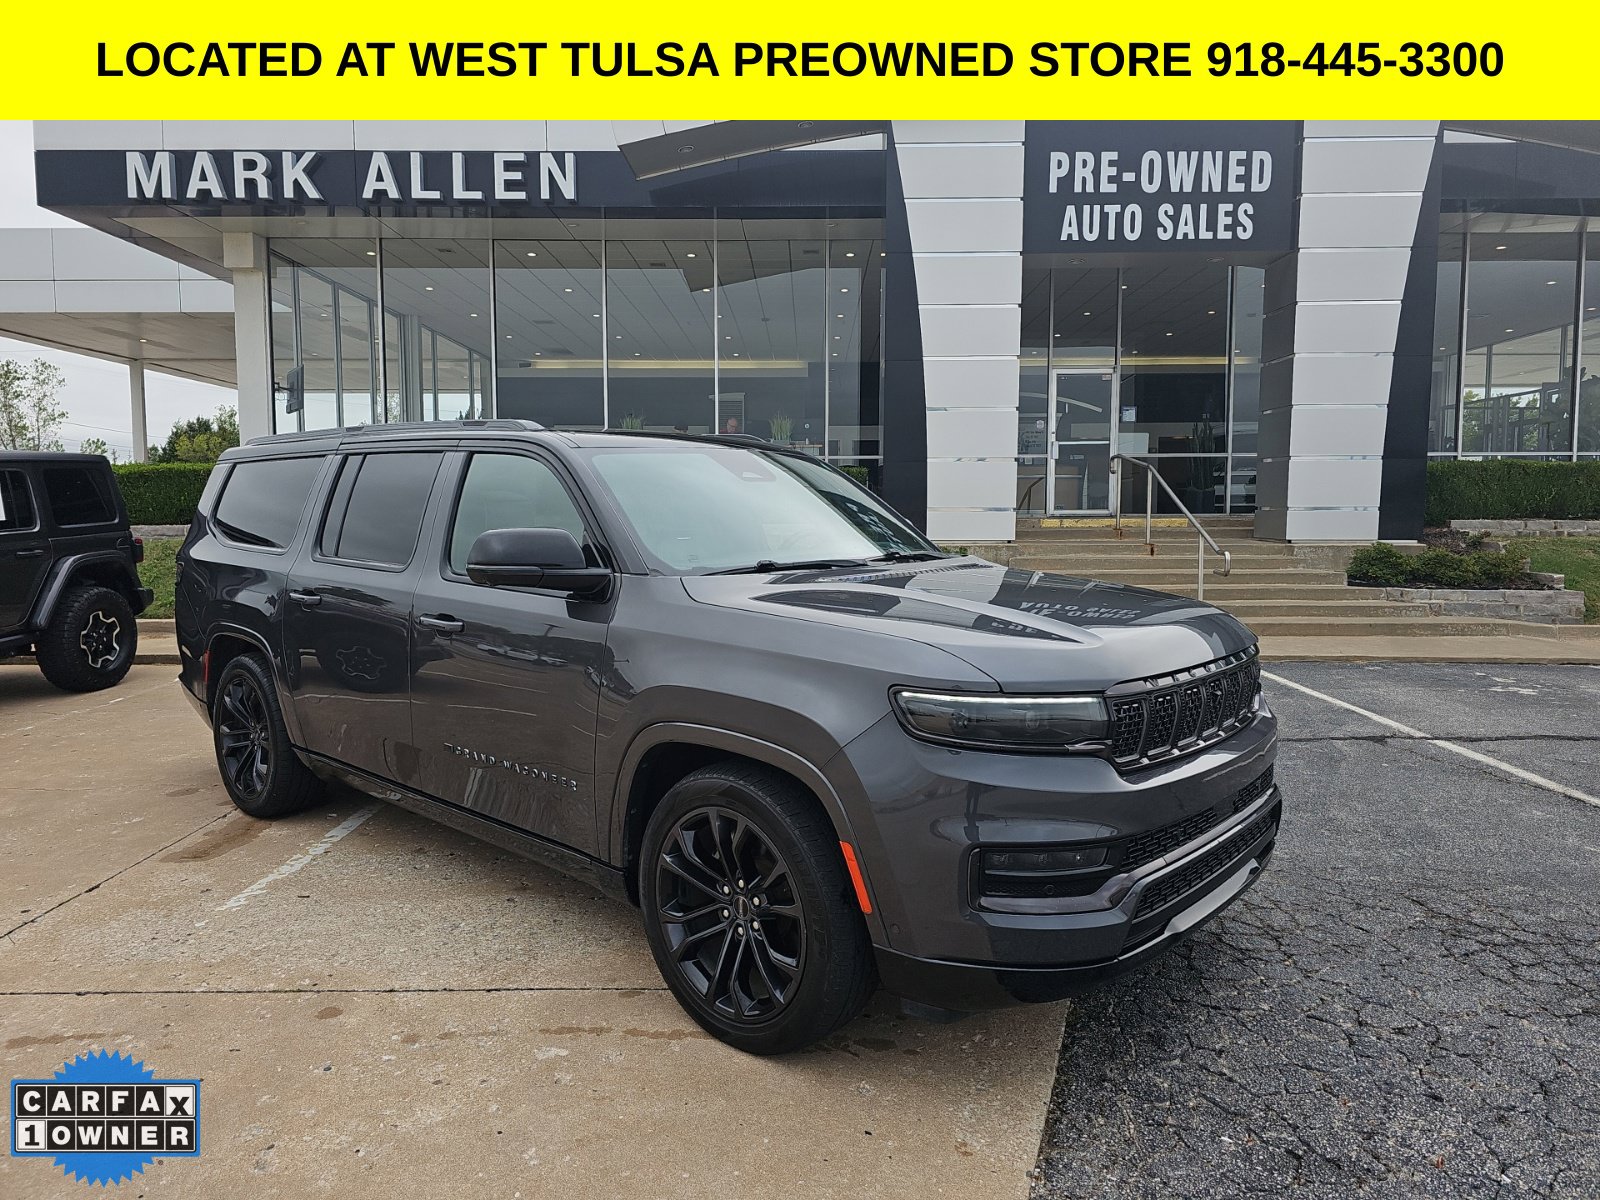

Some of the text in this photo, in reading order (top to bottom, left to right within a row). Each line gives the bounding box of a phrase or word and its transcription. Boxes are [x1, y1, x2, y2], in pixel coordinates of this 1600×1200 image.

[125, 151, 578, 201] MARK ALLEN
[1049, 150, 1272, 194] PRE-OWNED
[1060, 202, 1254, 241] AUTO SALES
[455, 745, 578, 791] GRAND WAGONEER
